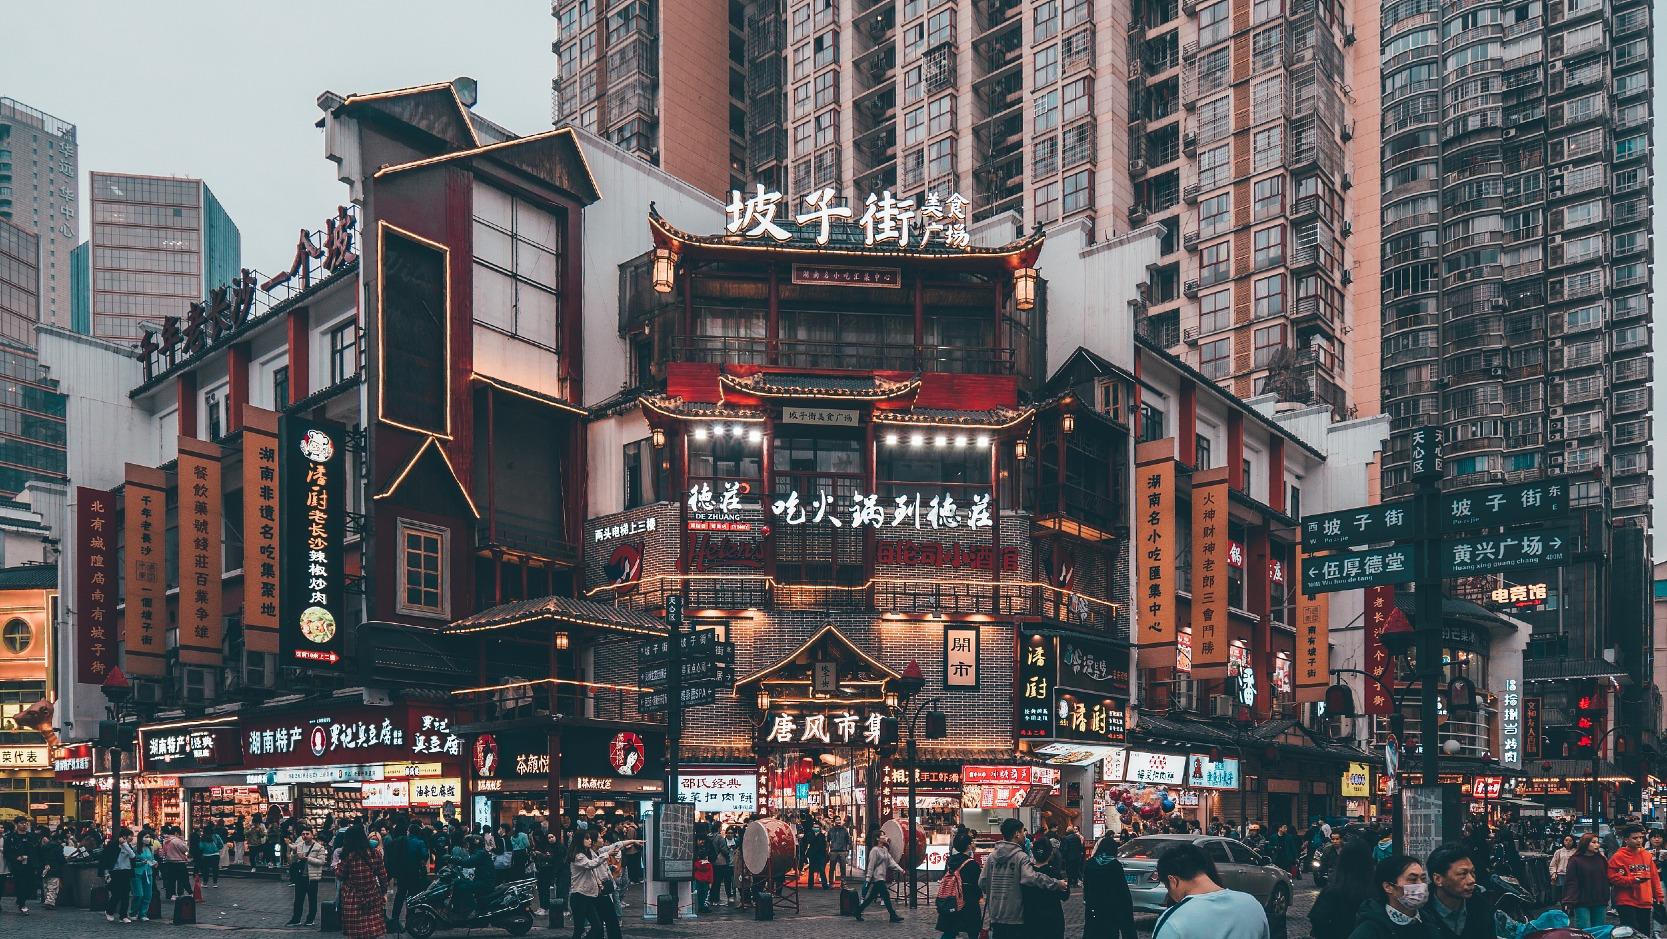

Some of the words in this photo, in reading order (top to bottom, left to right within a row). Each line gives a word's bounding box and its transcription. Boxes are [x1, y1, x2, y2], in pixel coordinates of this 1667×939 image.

[725, 184, 915, 248] 坡子街
[921, 192, 970, 220] 美食
[920, 223, 971, 249] 广场
[789, 411, 853, 423] 坡子街美食广场
[1412, 431, 1424, 473] 天心区
[1451, 488, 1542, 517] 坡子街
[1549, 485, 1561, 497] 东
[708, 513, 740, 521] ZHUANG
[1308, 521, 1318, 533] 西
[1323, 509, 1404, 536] 坡子街
[1147, 474, 1162, 633] 湖南名小吃匯集中心
[1453, 535, 1543, 565] 黄兴广场
[1322, 552, 1405, 580] 伍厚德堂
[90, 500, 106, 676] 北有城隍庙南有坡子街
[1491, 583, 1547, 603] 电竞馆
[950, 637, 973, 677] 開市
[249, 726, 303, 755] 湖南特产
[766, 712, 885, 745] 唐风市集
[2, 750, 38, 763] 菜代表
[149, 735, 185, 755] 湖南特产
